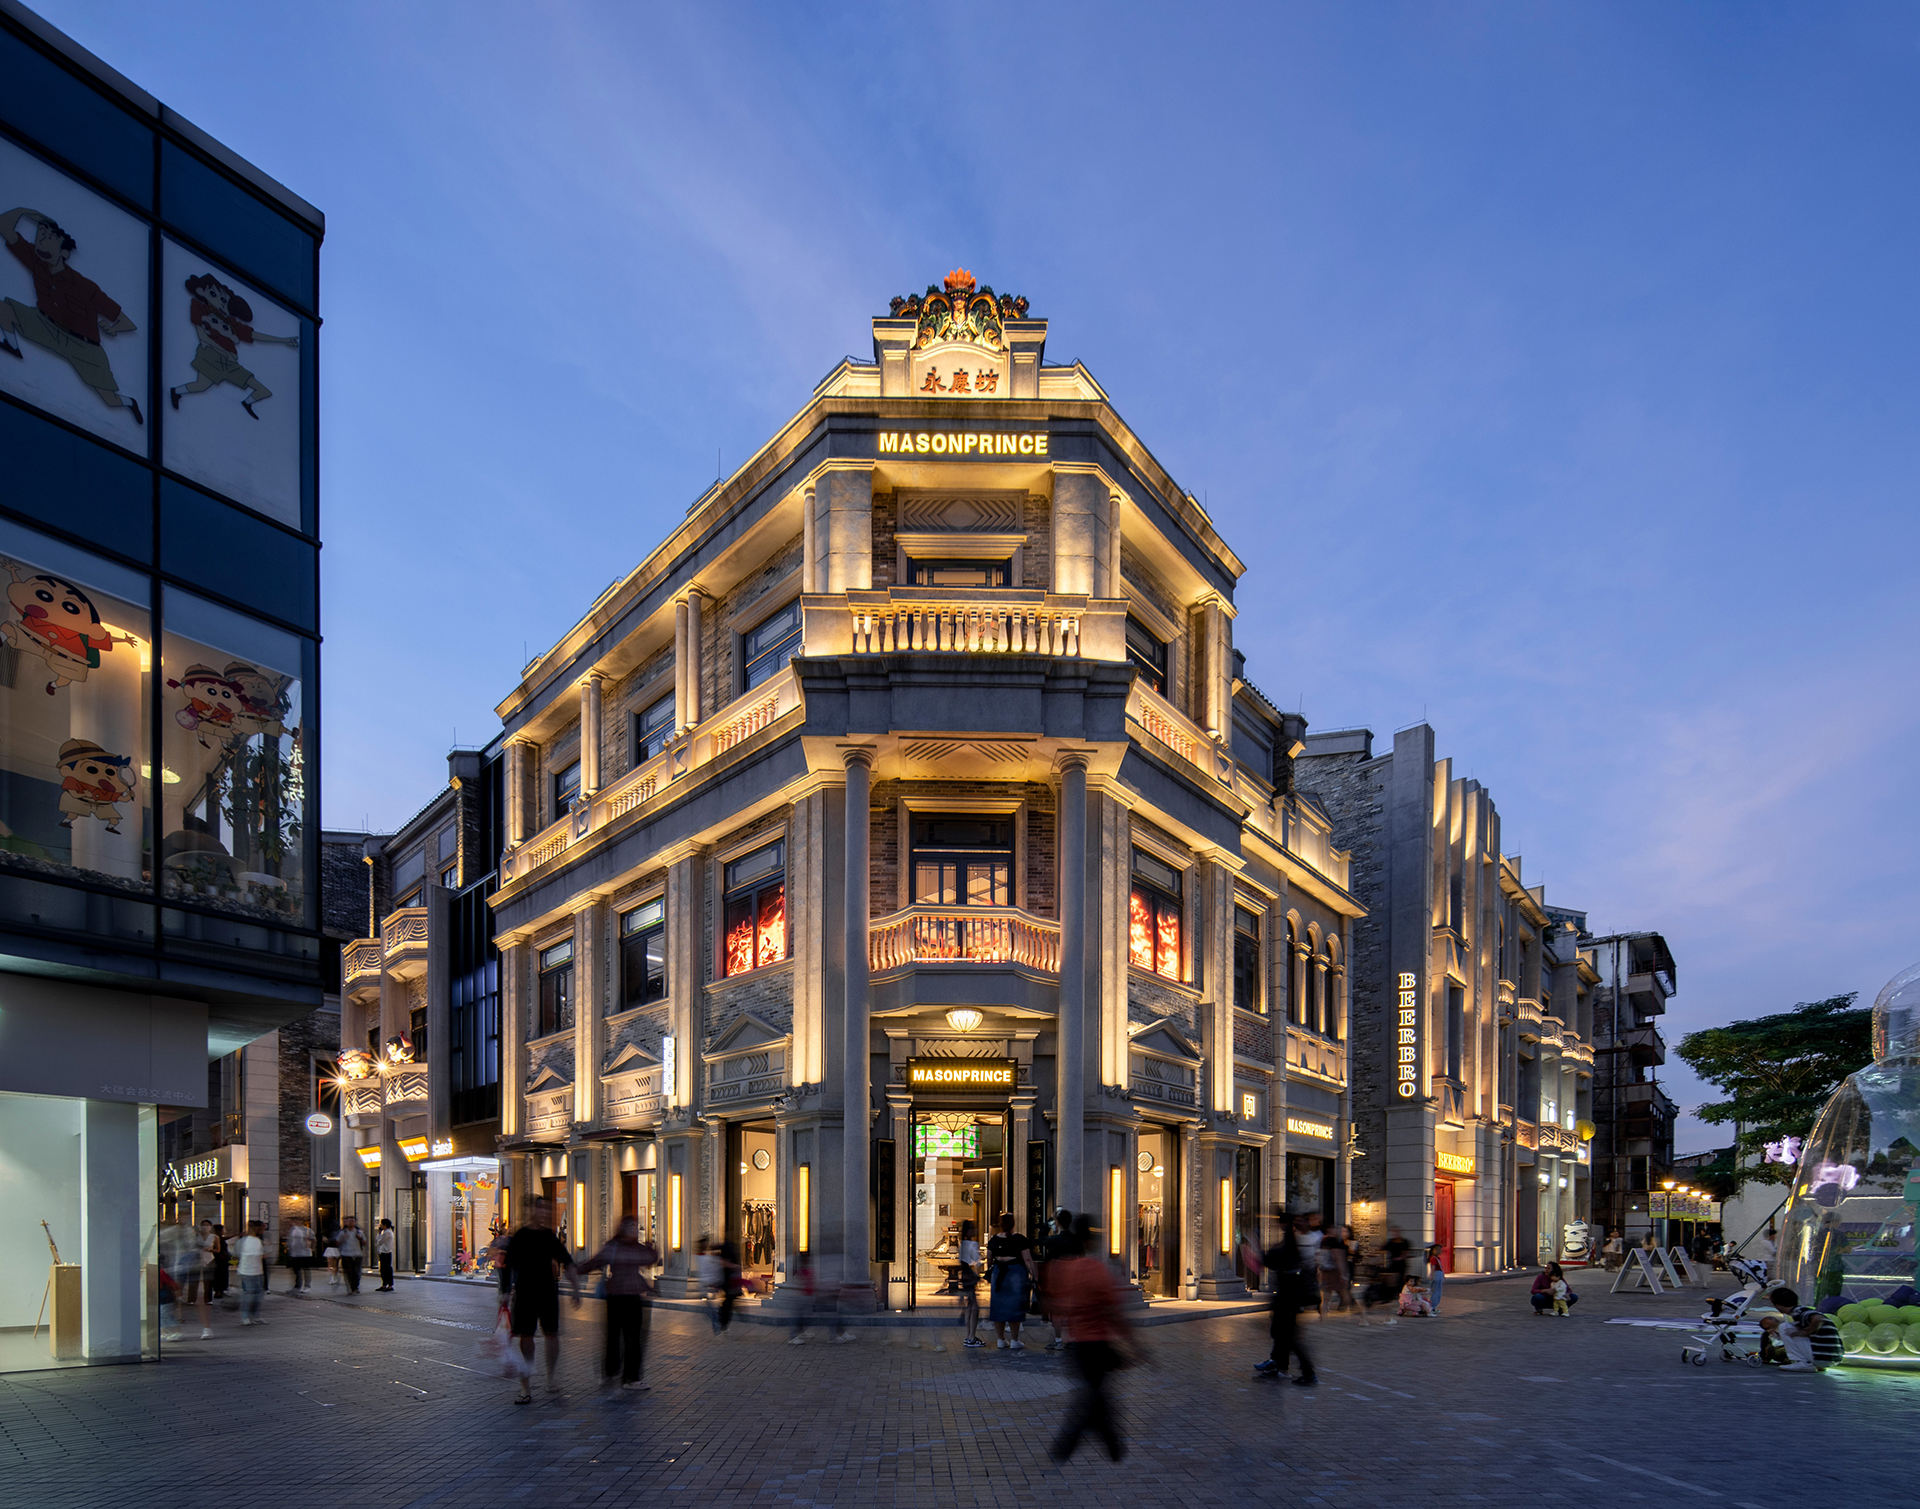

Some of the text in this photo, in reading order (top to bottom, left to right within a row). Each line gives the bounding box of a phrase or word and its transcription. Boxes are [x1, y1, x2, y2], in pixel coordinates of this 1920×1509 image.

[879, 432, 1049, 455] MASONPRINCE
[1398, 972, 1417, 1098] BEERBRO
[912, 1068, 1012, 1083] MASONPRINCE
[1286, 1117, 1334, 1140] MASONPRINCE
